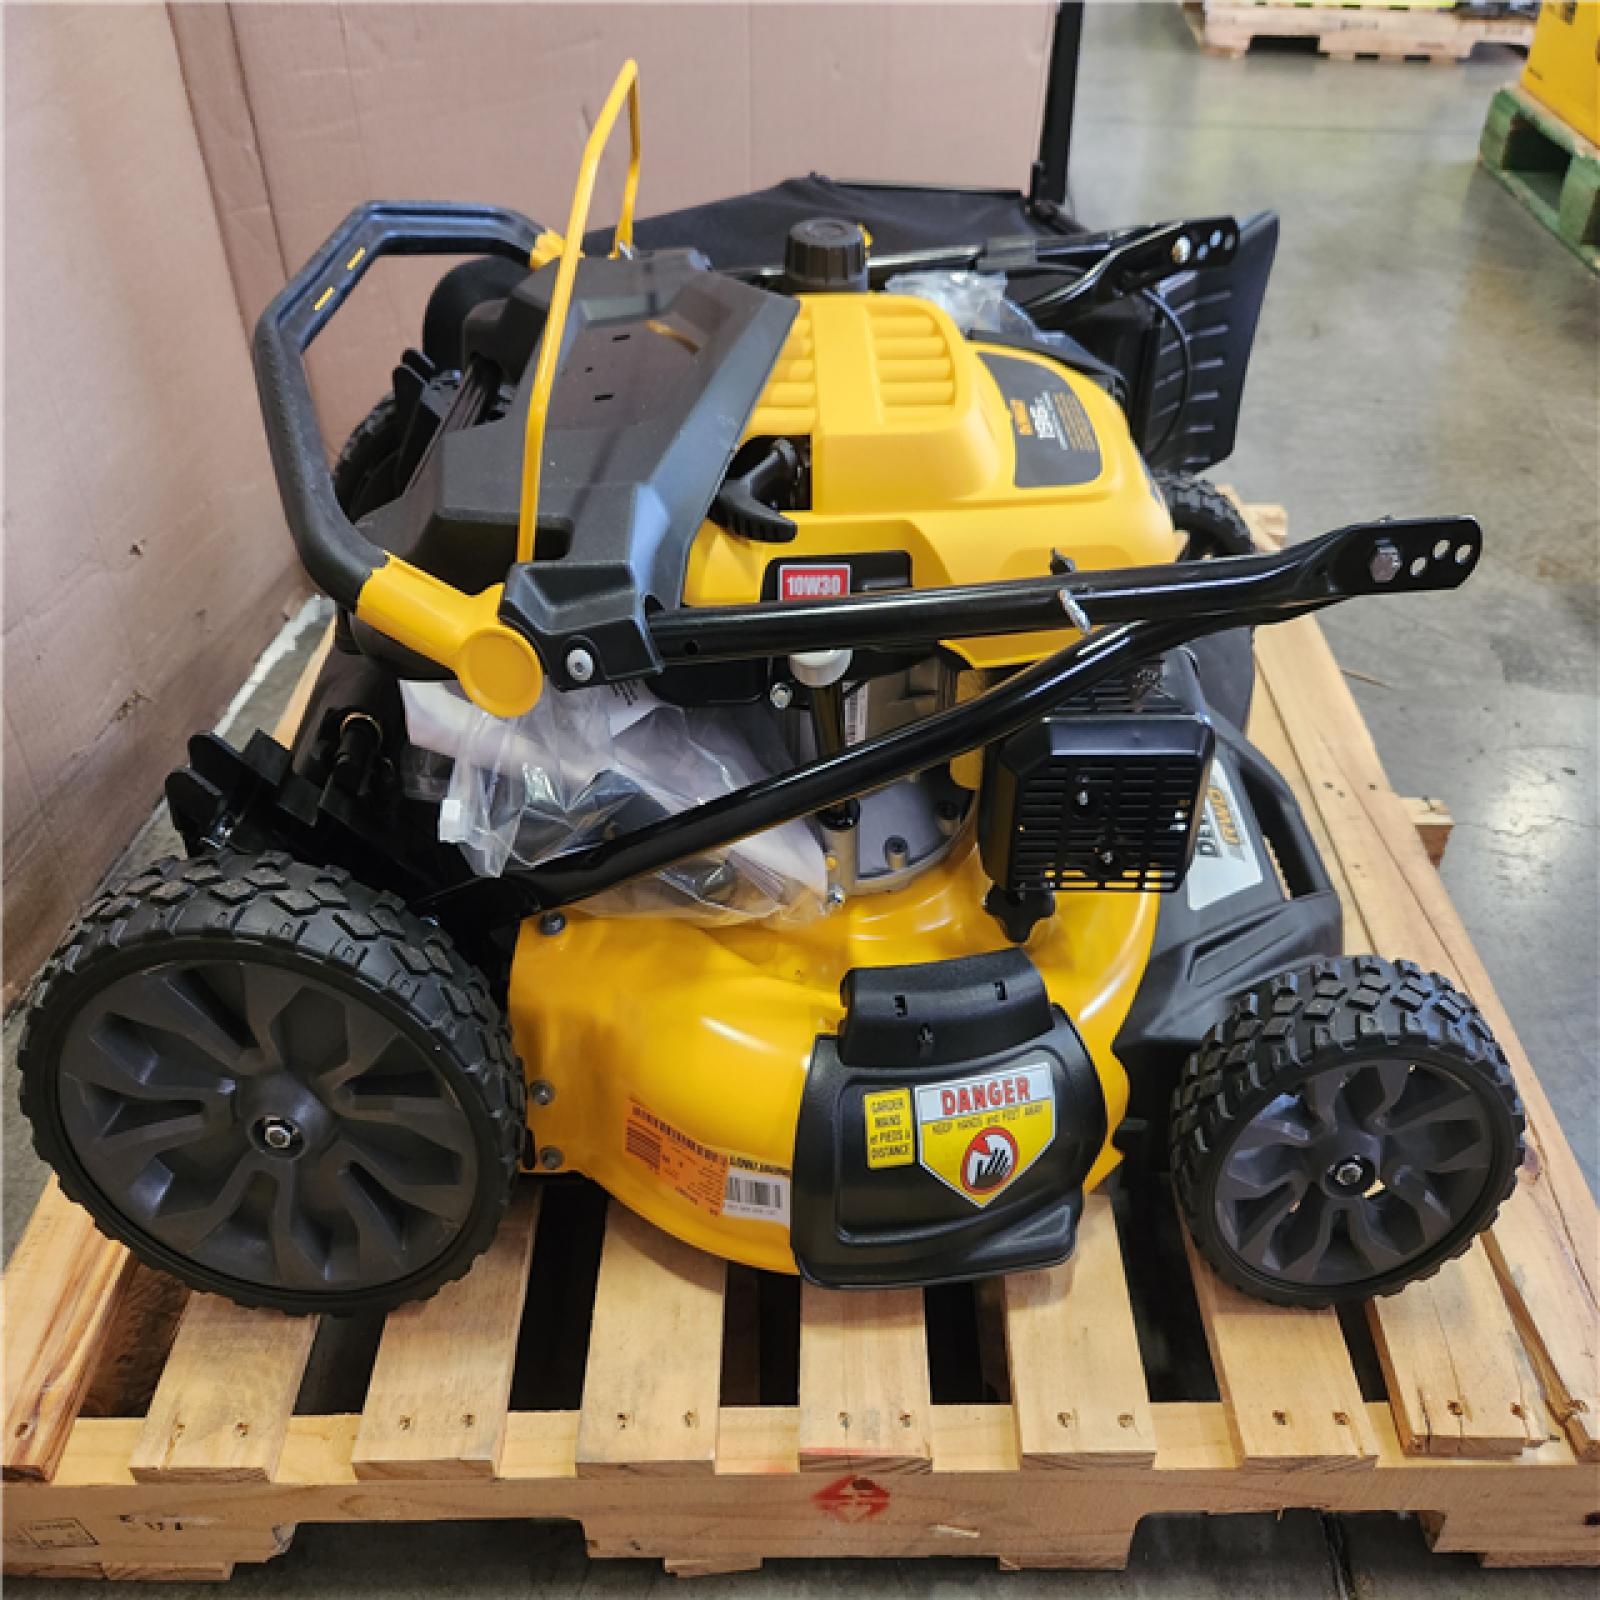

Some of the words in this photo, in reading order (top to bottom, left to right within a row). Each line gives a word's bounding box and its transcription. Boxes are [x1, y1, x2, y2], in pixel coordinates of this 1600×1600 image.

[787, 574, 841, 596] 10W30
[941, 1076, 1031, 1116] DANGER
[957, 1115, 983, 1130] HANDS
[872, 1144, 909, 1160] DISTANCE
